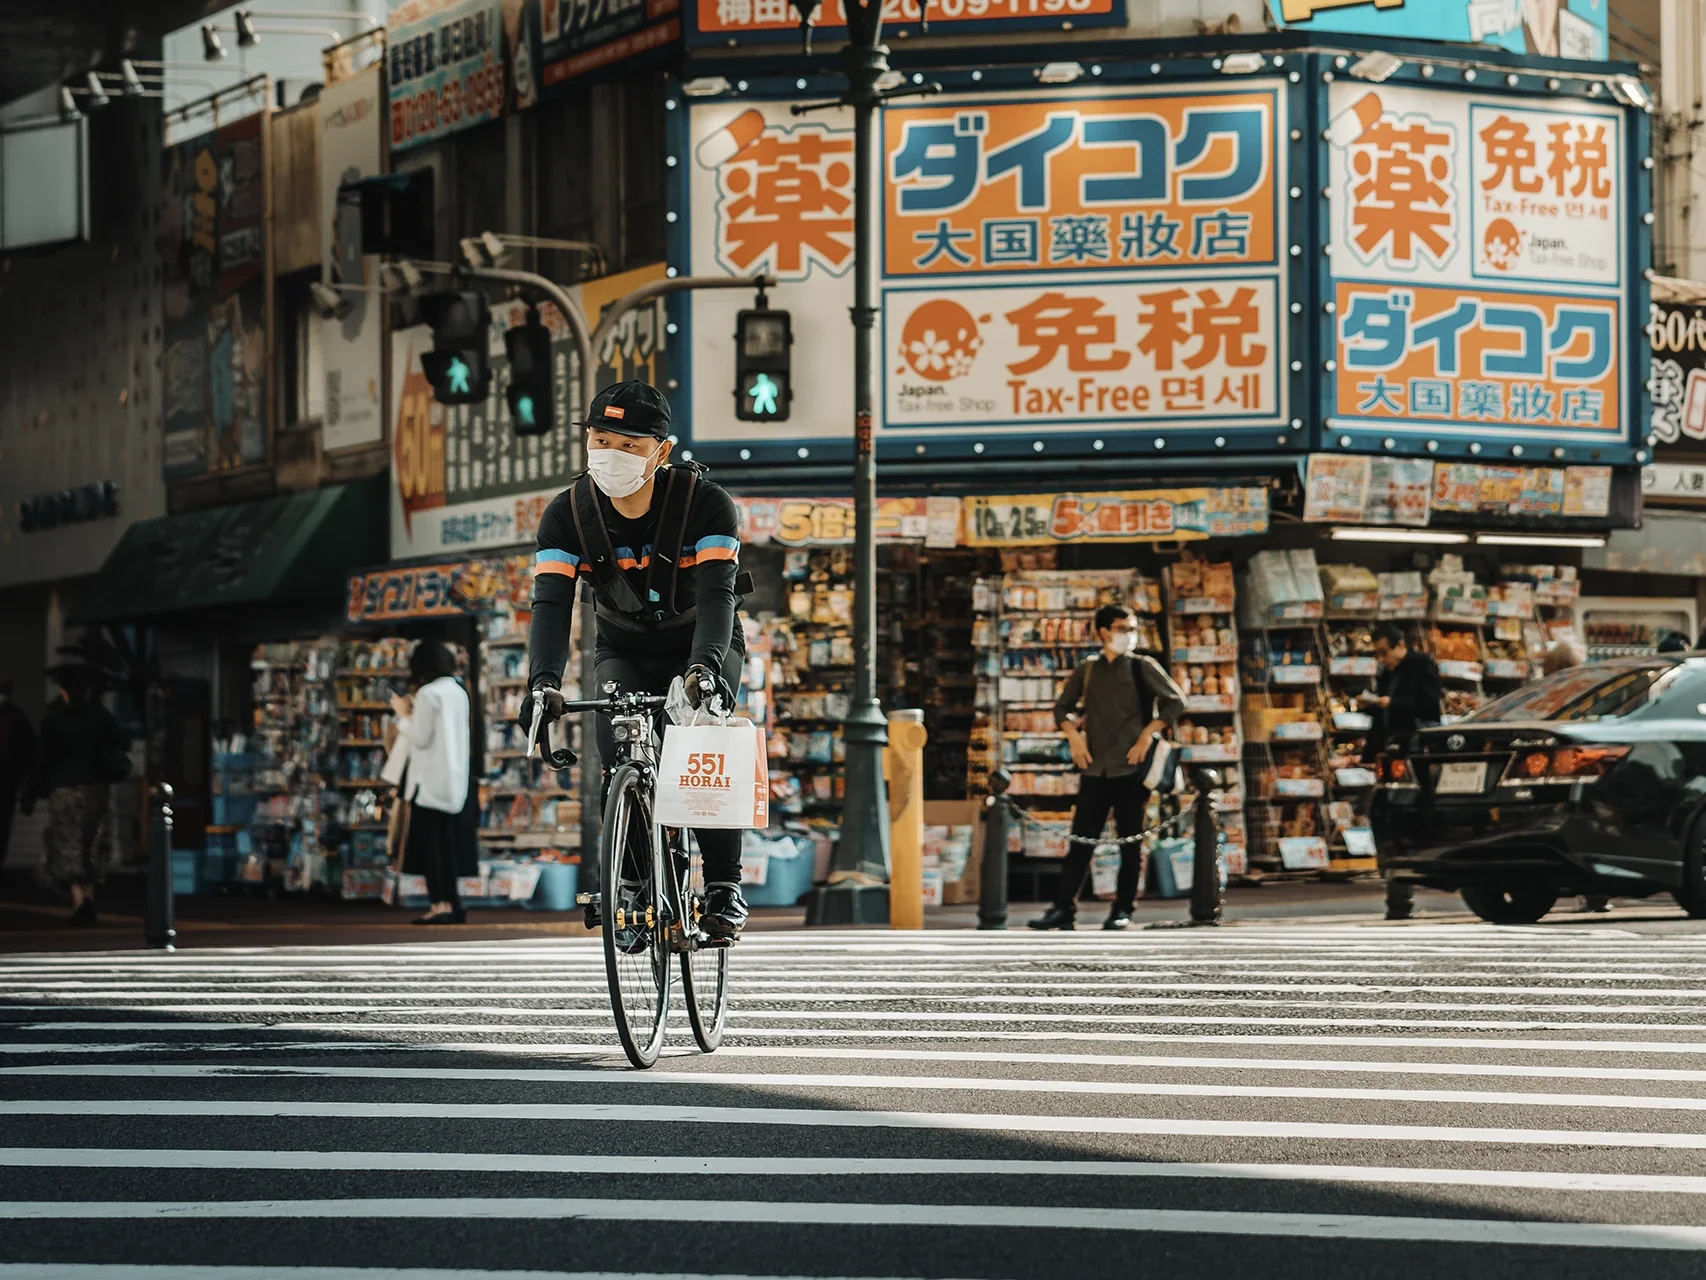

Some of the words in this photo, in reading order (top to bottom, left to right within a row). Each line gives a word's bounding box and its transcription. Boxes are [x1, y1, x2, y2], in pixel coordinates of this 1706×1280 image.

[893, 109, 1267, 214] ダイコク
[1352, 120, 1453, 262] 薬
[1479, 115, 1613, 200] 免税
[1484, 195, 1559, 218] Tax-Free
[1005, 287, 1268, 376] 免税
[1340, 291, 1616, 384] ダイコク
[1007, 378, 1151, 415] Tax-Free
[1161, 374, 1263, 412] 면세
[679, 775, 731, 788] HORAI
[687, 753, 725, 776] 551
